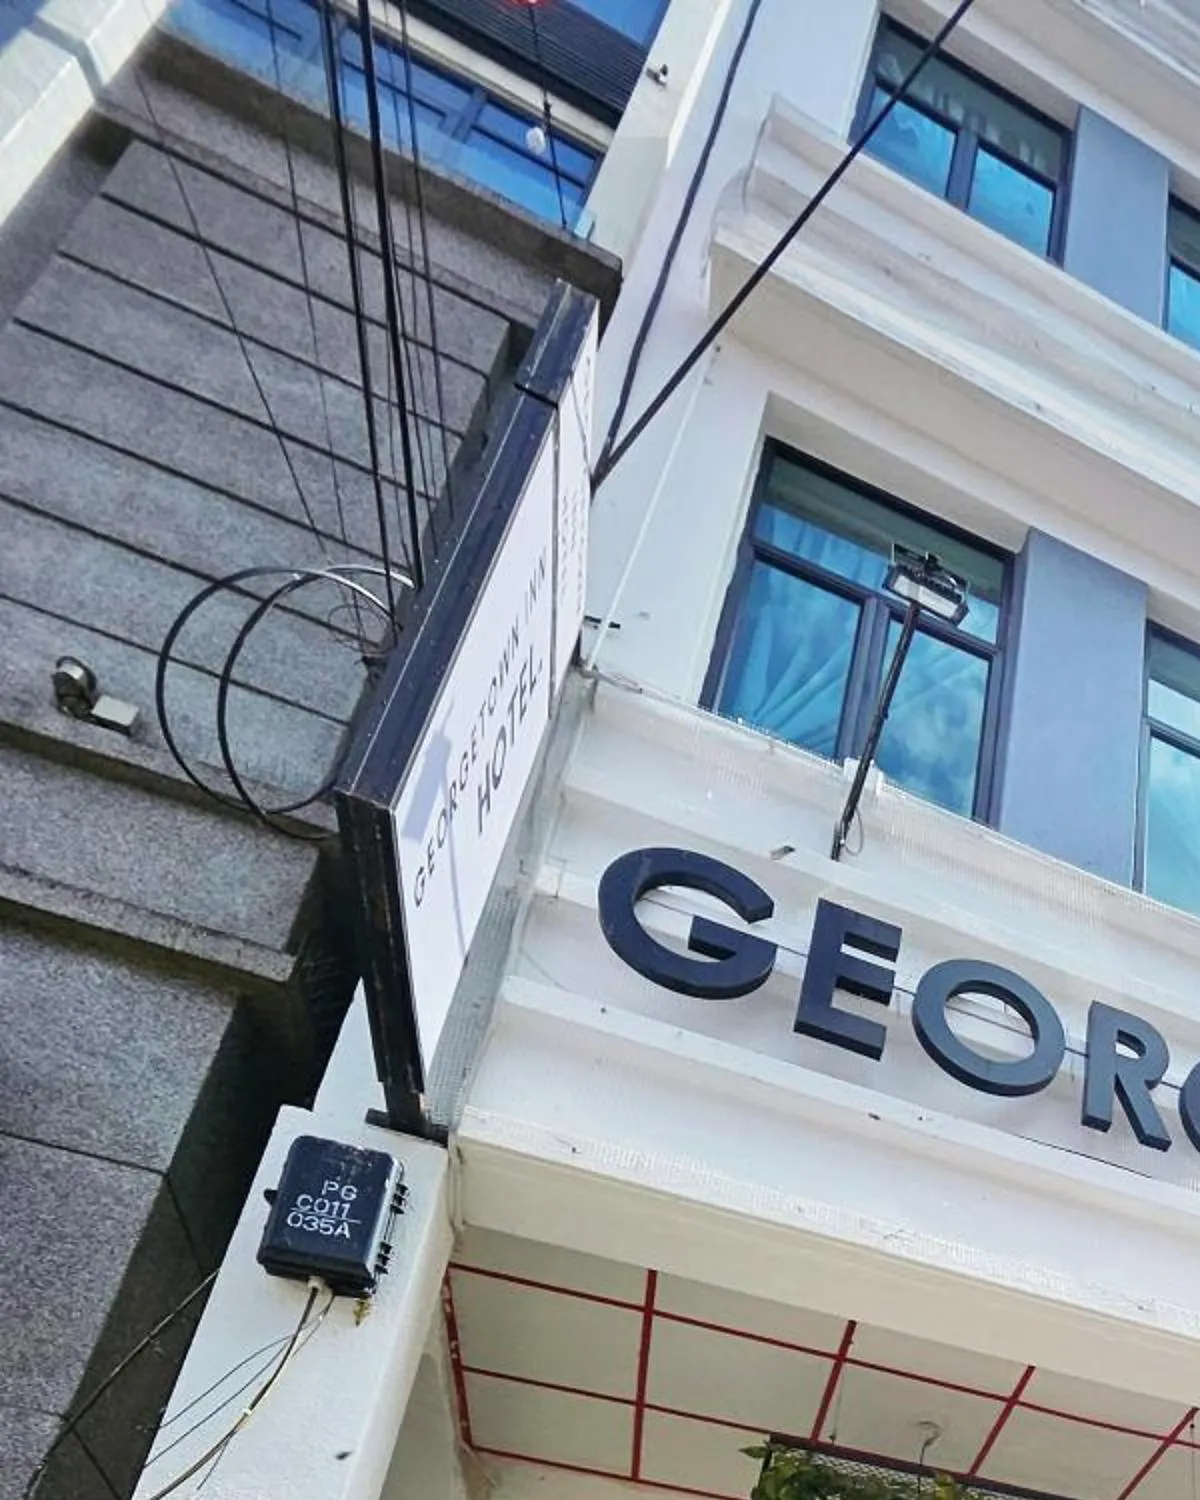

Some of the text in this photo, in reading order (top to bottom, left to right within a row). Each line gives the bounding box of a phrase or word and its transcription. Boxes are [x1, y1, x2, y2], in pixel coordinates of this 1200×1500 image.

[412, 545, 547, 908] GEORGETOWN INN
[321, 1179, 359, 1201] PG
[286, 1211, 351, 1240] 035A
